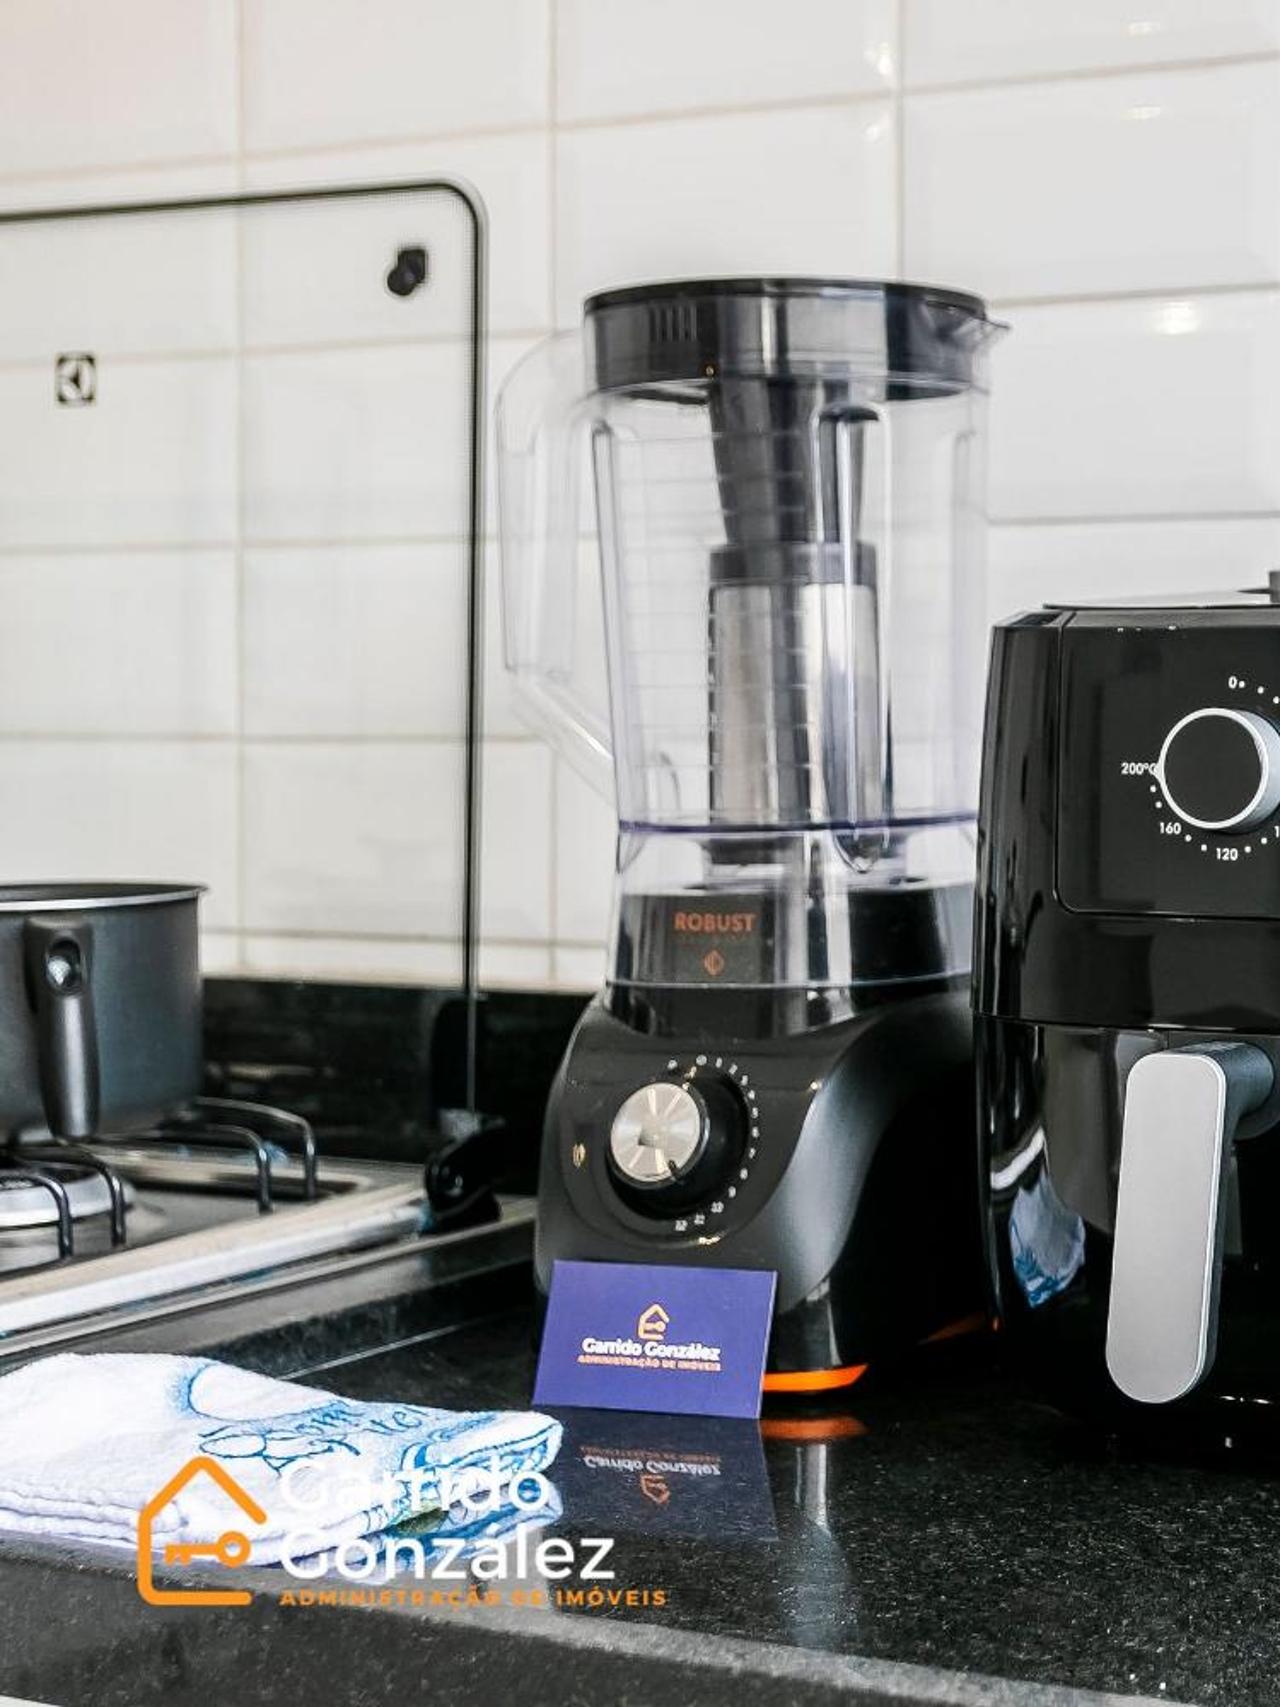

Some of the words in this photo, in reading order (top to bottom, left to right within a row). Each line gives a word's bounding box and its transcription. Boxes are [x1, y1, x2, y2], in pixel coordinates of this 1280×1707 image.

[1159, 822, 1182, 835] 160
[1215, 848, 1239, 861] 120
[674, 911, 757, 932] ROBUST
[582, 1337, 642, 1356] Garrido
